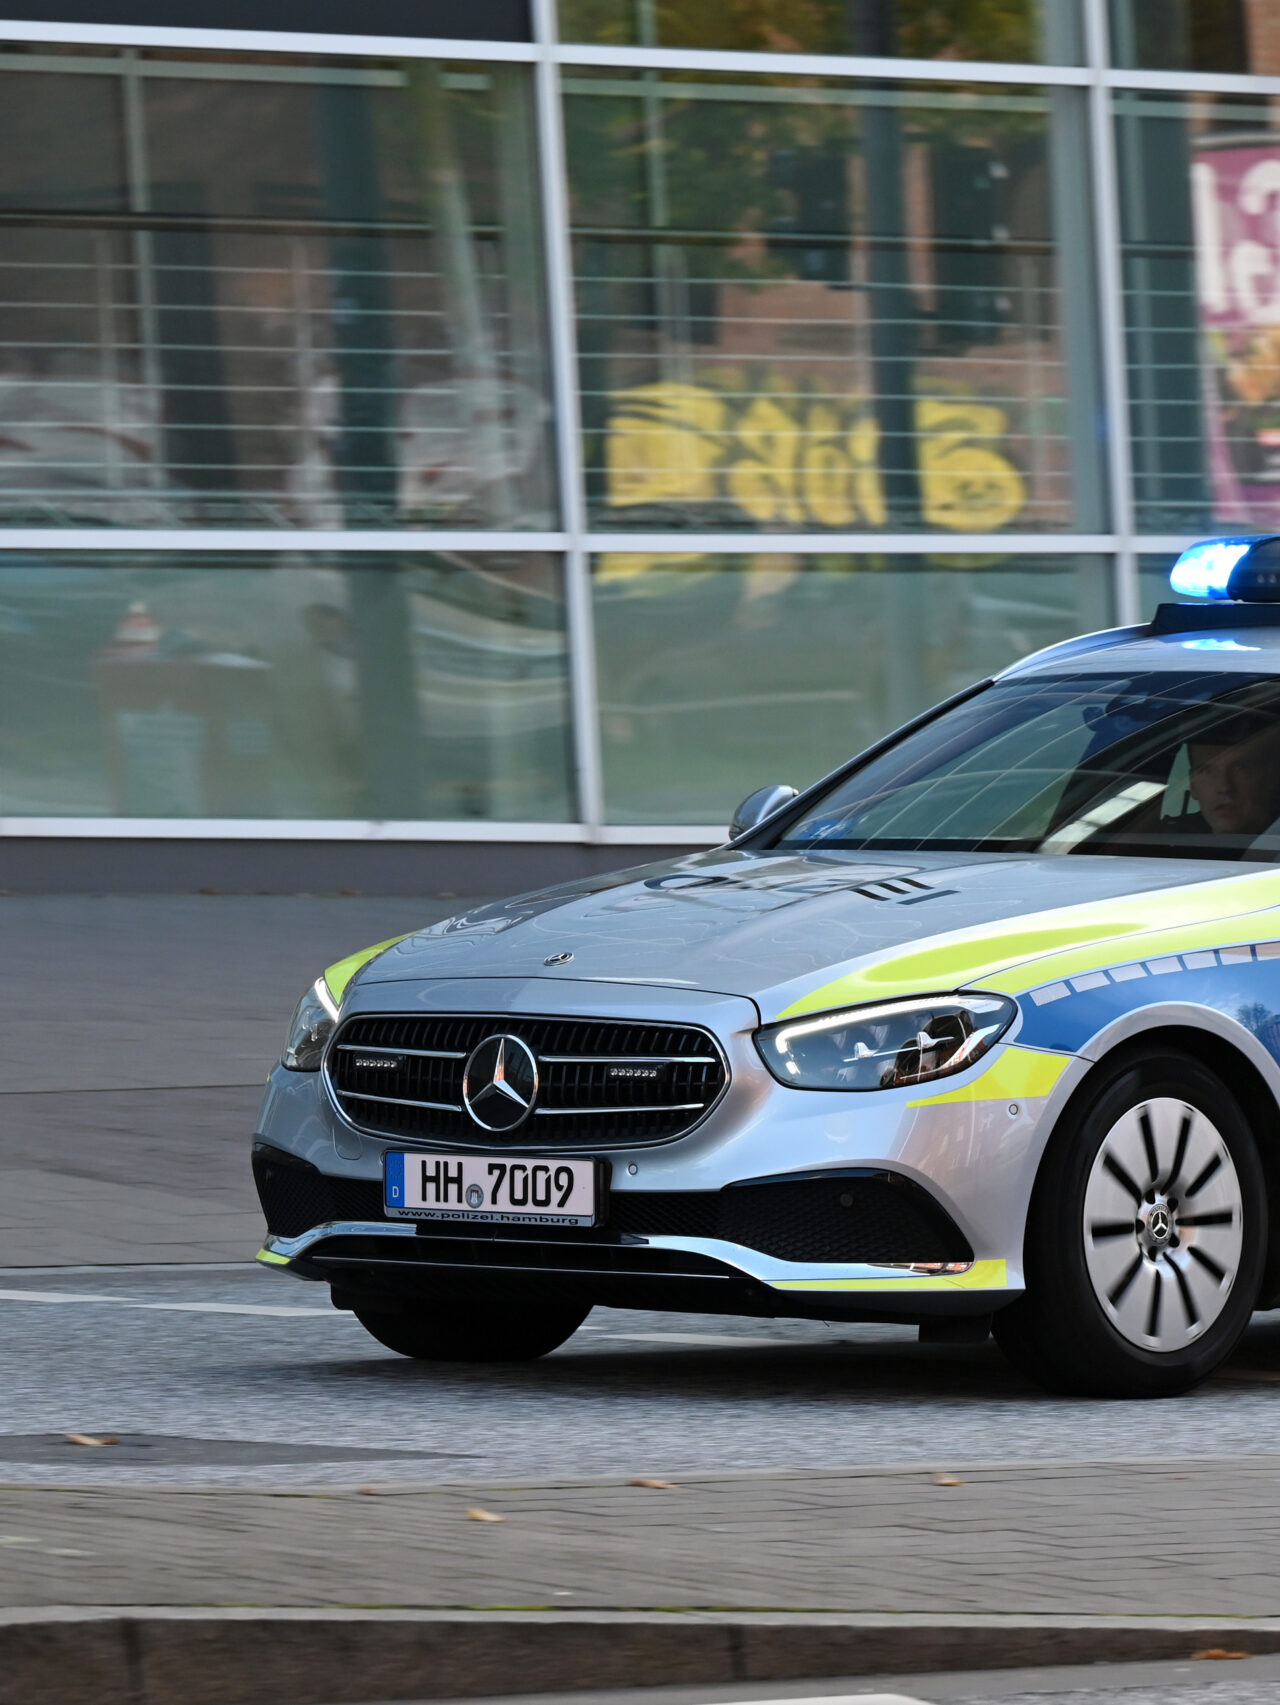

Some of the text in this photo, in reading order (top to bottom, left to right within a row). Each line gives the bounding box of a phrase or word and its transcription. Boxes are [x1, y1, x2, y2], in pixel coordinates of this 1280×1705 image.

[421, 1159, 575, 1208] HH 7009
[391, 1186, 400, 1198] D
[398, 1210, 579, 1225] www.polizei.hamburg
